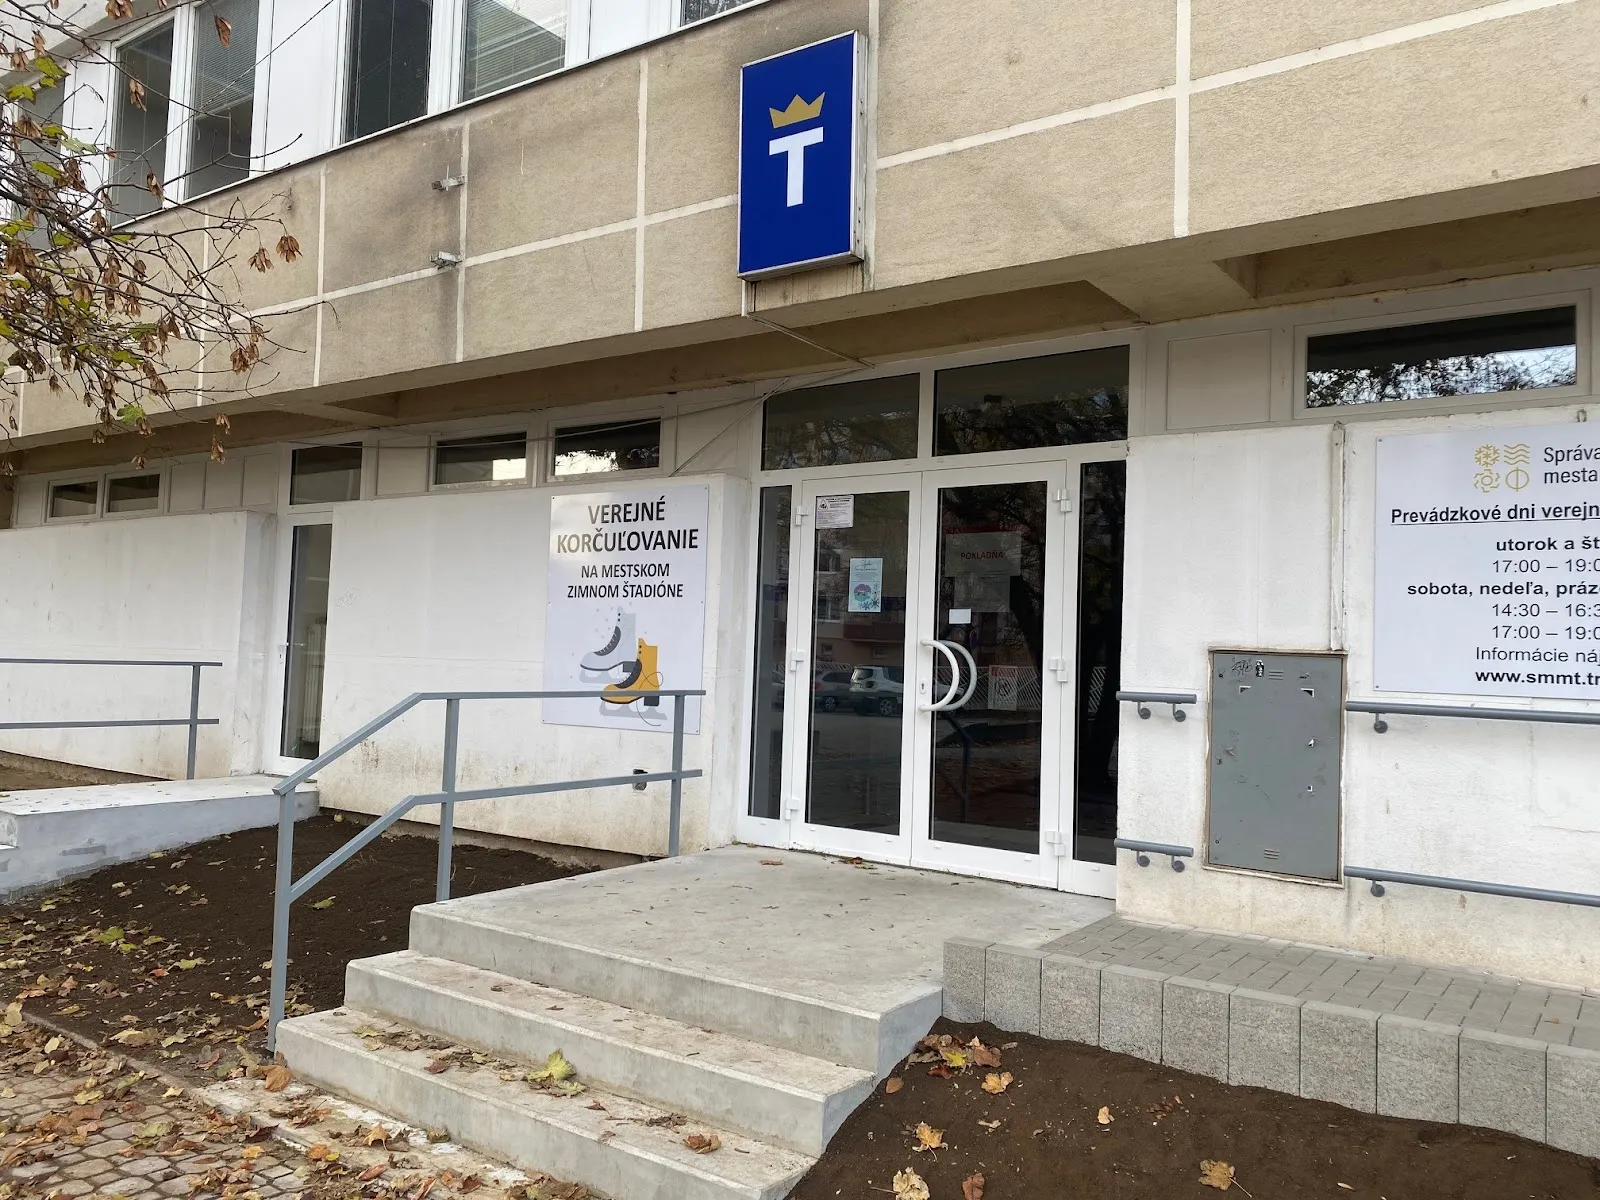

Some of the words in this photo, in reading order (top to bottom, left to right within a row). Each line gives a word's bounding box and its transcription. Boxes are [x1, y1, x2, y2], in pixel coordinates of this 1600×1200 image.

[769, 126, 824, 208] T
[1543, 444, 1600, 466] Správa
[1544, 467, 1598, 484] mesta
[588, 495, 666, 525] VEREJNÉ
[1391, 505, 1501, 523] Prevádzkové
[1507, 504, 1536, 520] dni
[1542, 502, 1600, 521] verejn
[557, 528, 699, 554] KORČUĽOVANIE
[1496, 537, 1557, 551] utorok
[1564, 541, 1575, 550] a
[1581, 536, 1600, 550] št
[581, 565, 598, 578] NA
[601, 563, 670, 578] MESTSKOM
[1492, 559, 1541, 573] 17:00
[567, 585, 619, 598] ZIMNOM
[622, 580, 683, 598] ŠTADIÓNE
[1407, 582, 1473, 597] sobota,
[1479, 581, 1549, 597] nedeľa,
[1556, 581, 1600, 597] práz
[1492, 603, 1540, 617] 14:30
[1492, 625, 1540, 639] 17:00
[1475, 646, 1569, 662] Informácie
